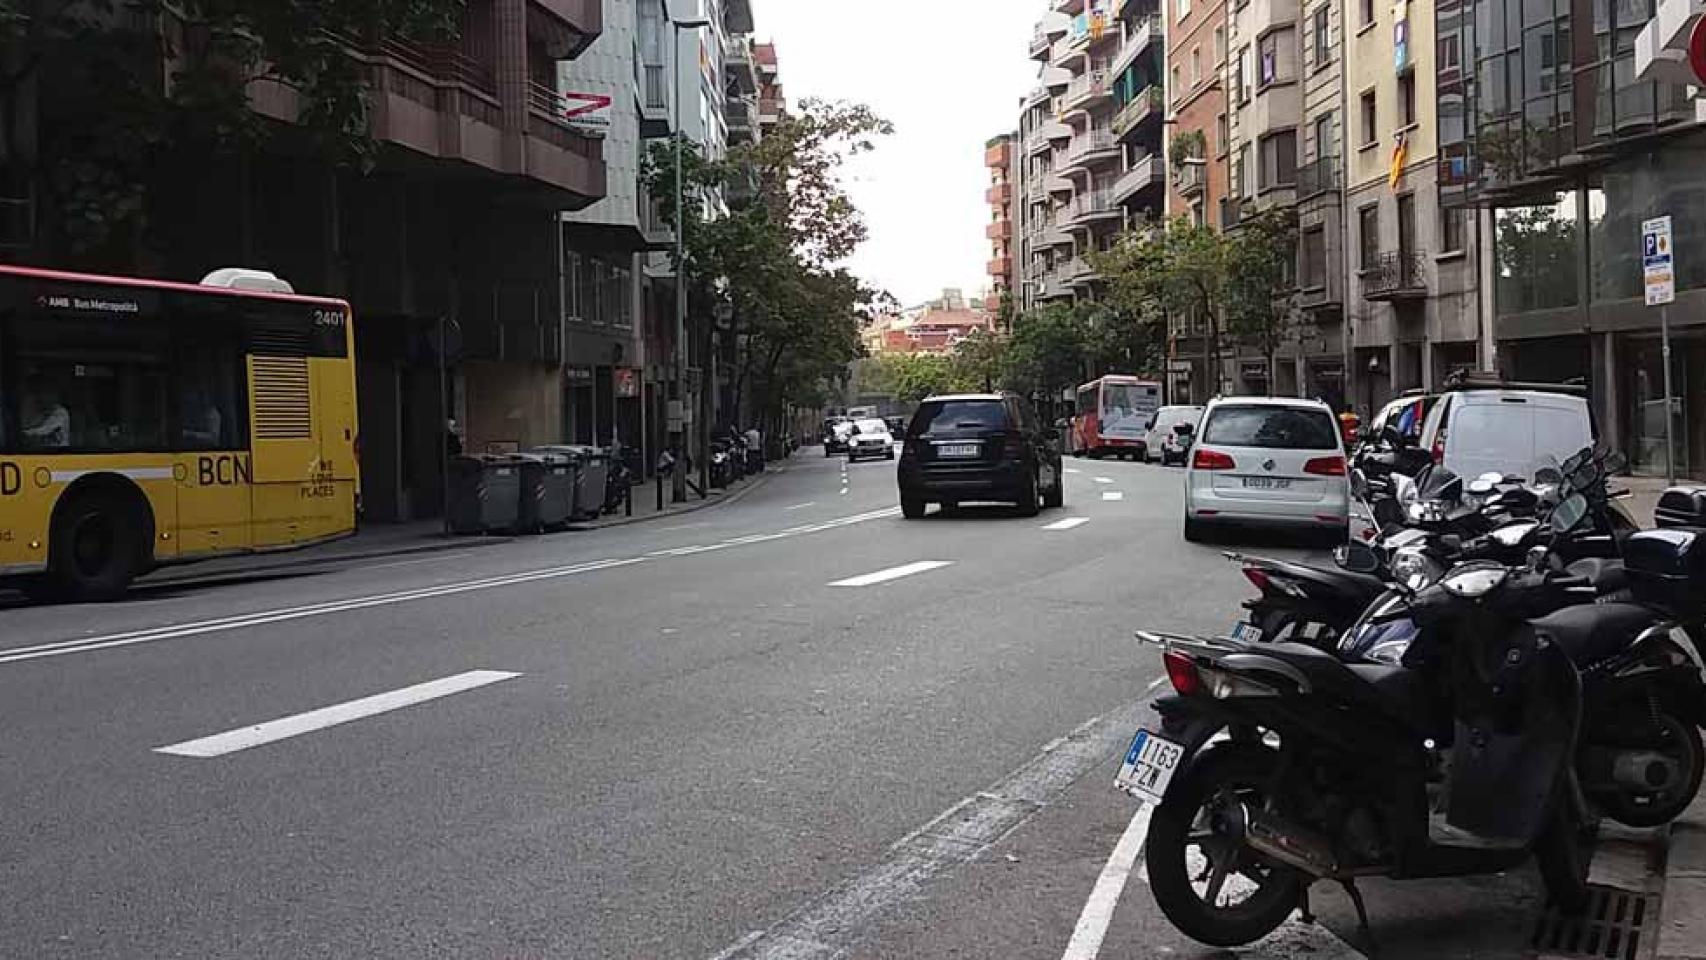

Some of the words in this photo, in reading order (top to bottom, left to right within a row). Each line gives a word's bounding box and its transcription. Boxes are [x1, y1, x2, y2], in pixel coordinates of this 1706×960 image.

[1646, 236, 1655, 255] P
[313, 310, 344, 326] 2401
[199, 455, 249, 485] BCN
[301, 485, 334, 497] PLACES
[1142, 739, 1179, 769] 1163
